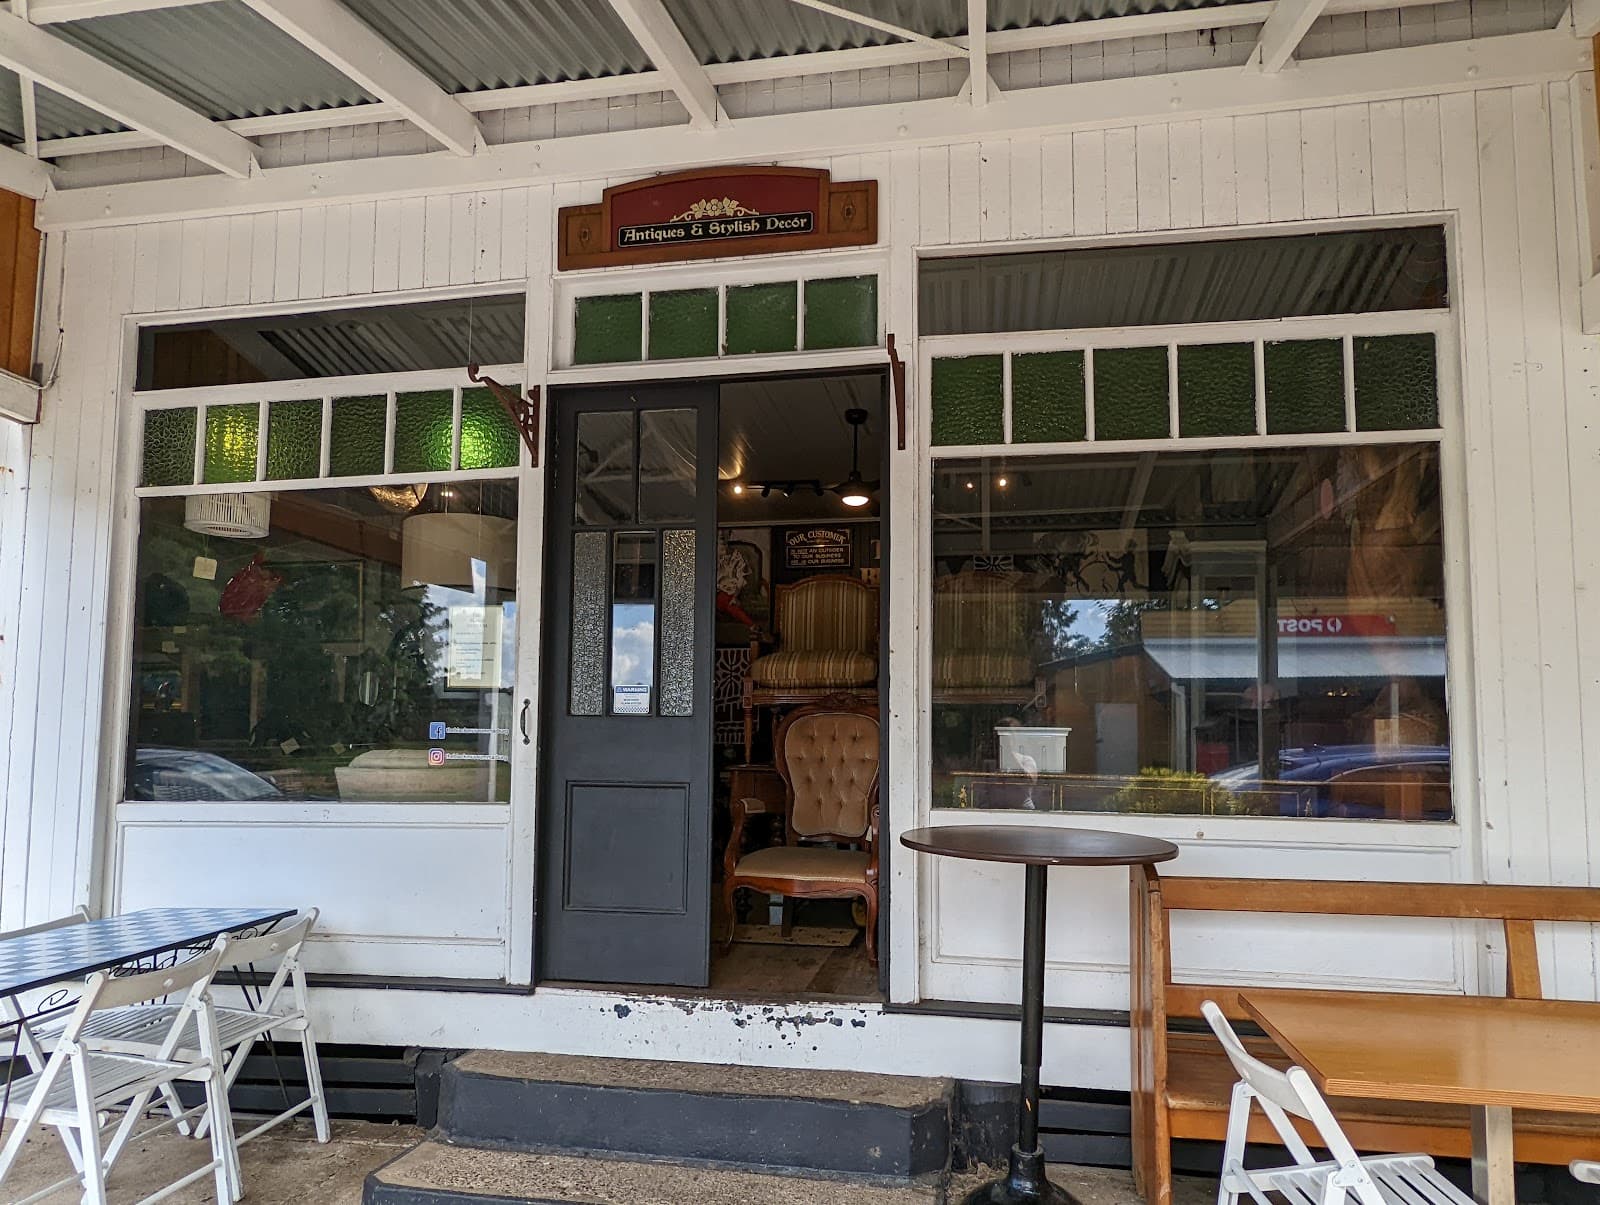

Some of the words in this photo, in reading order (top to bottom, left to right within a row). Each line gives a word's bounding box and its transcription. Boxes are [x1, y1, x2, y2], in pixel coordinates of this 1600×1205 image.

[624, 228, 685, 243] Antiques
[690, 223, 703, 236] &
[708, 219, 760, 236] Stylish
[789, 533, 807, 546] OUR
